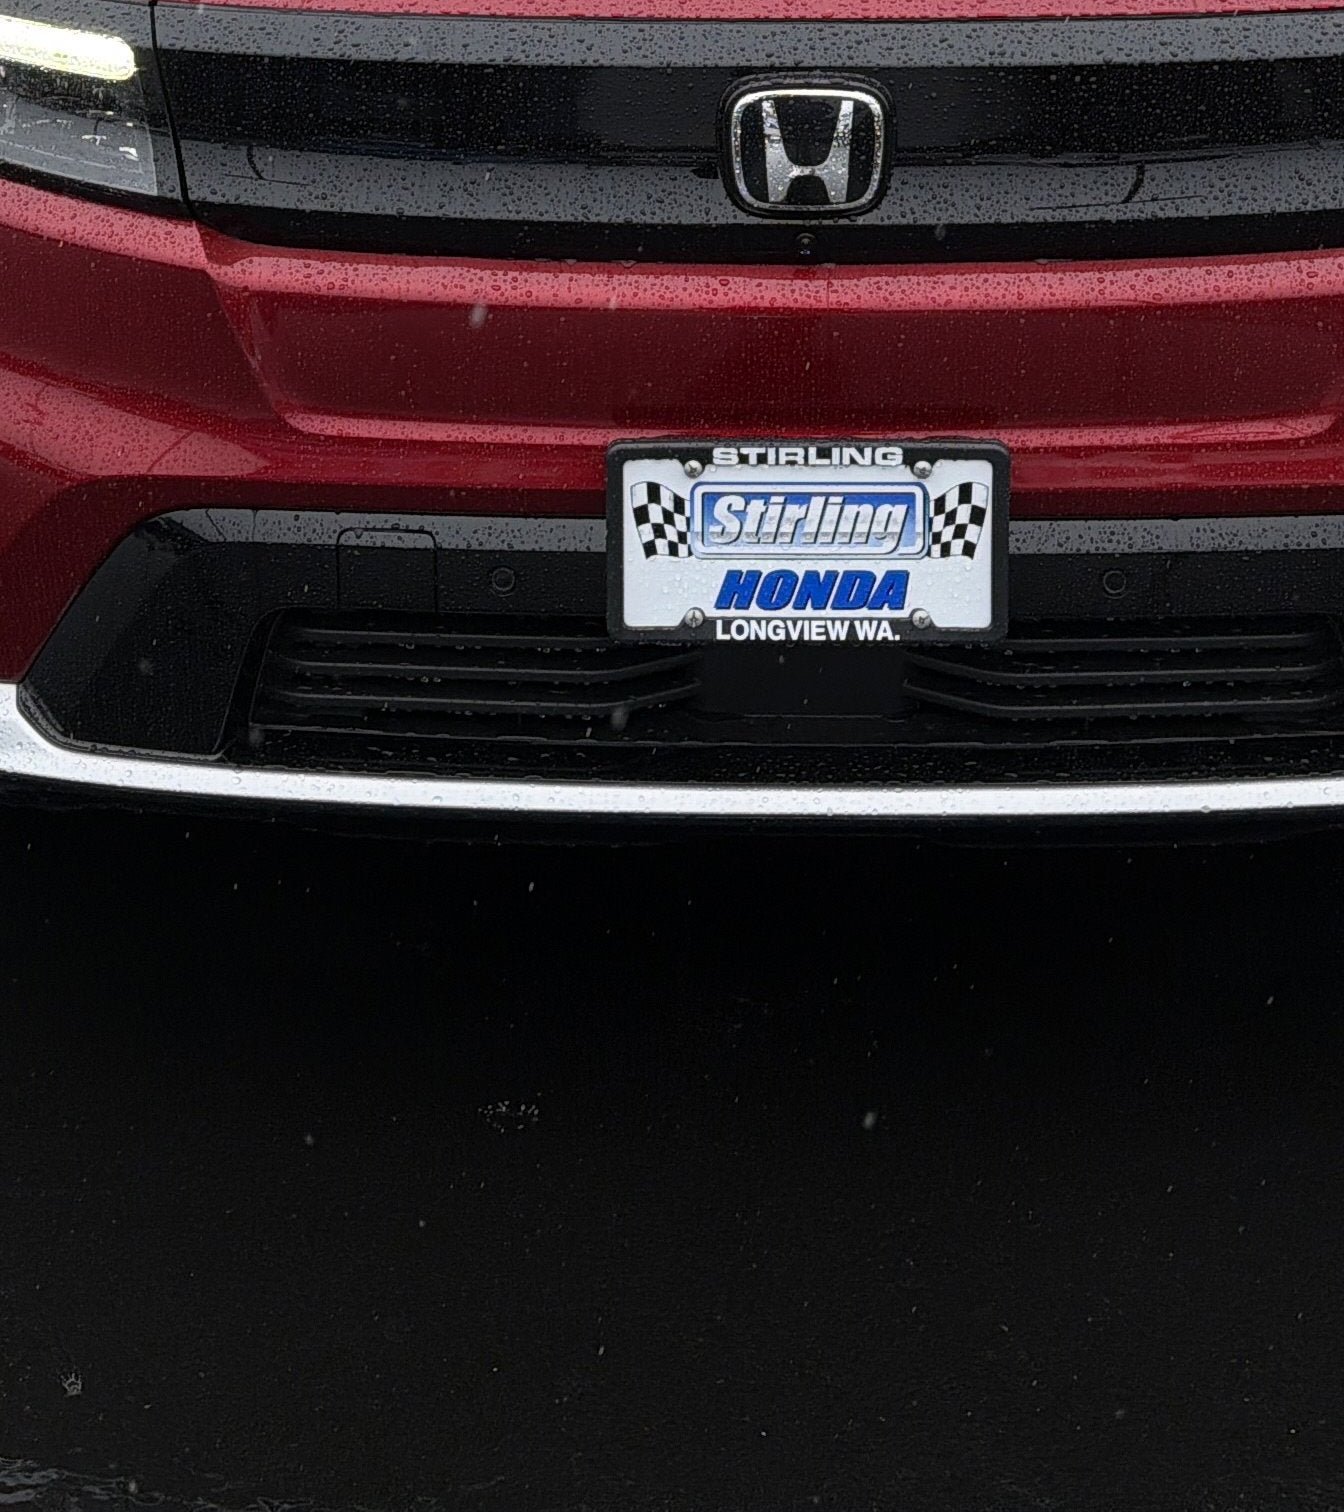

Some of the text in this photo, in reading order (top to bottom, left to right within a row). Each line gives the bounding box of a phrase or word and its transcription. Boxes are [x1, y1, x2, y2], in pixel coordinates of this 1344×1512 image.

[712, 446, 904, 466] STIRLING
[709, 495, 908, 555] Stirling
[714, 569, 910, 611] HONDA
[715, 619, 901, 641] LONGVIEW WA.
